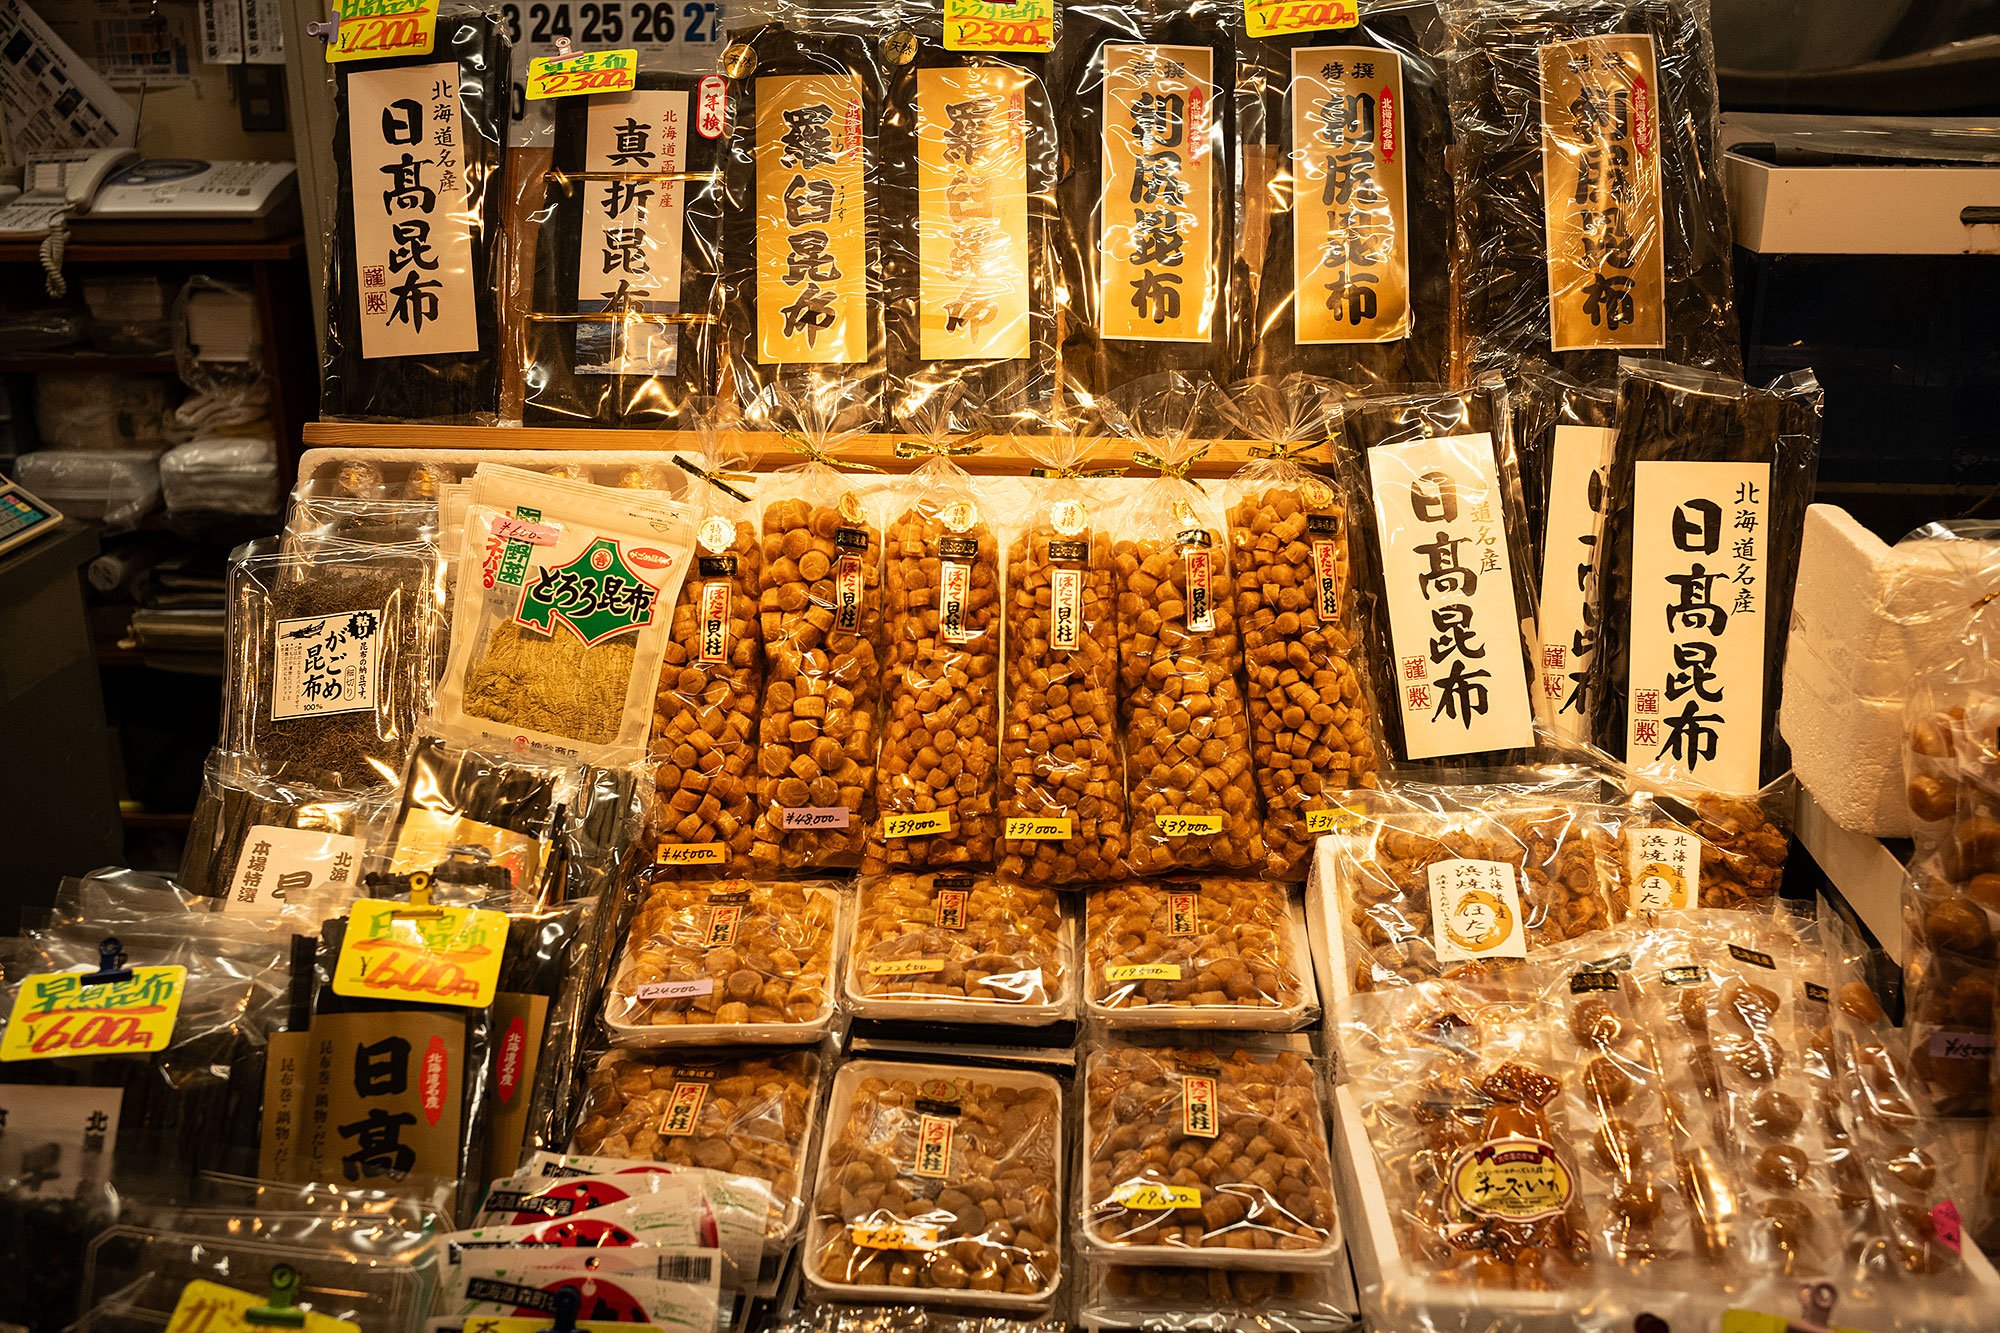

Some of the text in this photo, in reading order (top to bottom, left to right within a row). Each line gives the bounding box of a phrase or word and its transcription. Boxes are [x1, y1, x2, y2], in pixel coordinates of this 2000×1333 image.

[503, 3, 717, 44] 3 24 25 26 27
[891, 41, 914, 55] 天然
[1320, 61, 1375, 79] 特撰
[430, 78, 460, 197] 北海道名産
[702, 82, 722, 133] 一等検
[1381, 97, 1394, 151] 北海道名産
[380, 98, 444, 336] 日高昆布
[779, 104, 842, 350] 羅臼昆布
[1319, 545, 1337, 615] ほたて貝柱
[1731, 481, 1760, 616] 北海道名産
[356, 615, 371, 638] 粘り
[532, 565, 655, 623] とろろ昆布
[705, 588, 725, 656] ほたて貝柱
[840, 561, 858, 628] ほたて貝柱
[945, 569, 964, 637] ほたて貝柱
[1057, 575, 1074, 642] ほたて貝柱
[1410, 471, 1492, 731] 日高昆布
[322, 627, 348, 701] がごめ
[1654, 498, 1730, 774] 日高昆布
[300, 643, 326, 702] 昆布
[303, 703, 324, 712] 100%
[1488, 865, 1507, 920] 北海道産
[1640, 834, 1668, 914] 浜焼きほた
[1672, 835, 1688, 895] 北海道産
[1455, 865, 1485, 944] 浜焼きほたて
[336, 1036, 417, 1184] 日高
[1190, 1080, 1211, 1130] ほたて貝柱
[922, 1121, 946, 1172] ほたて貝柱
